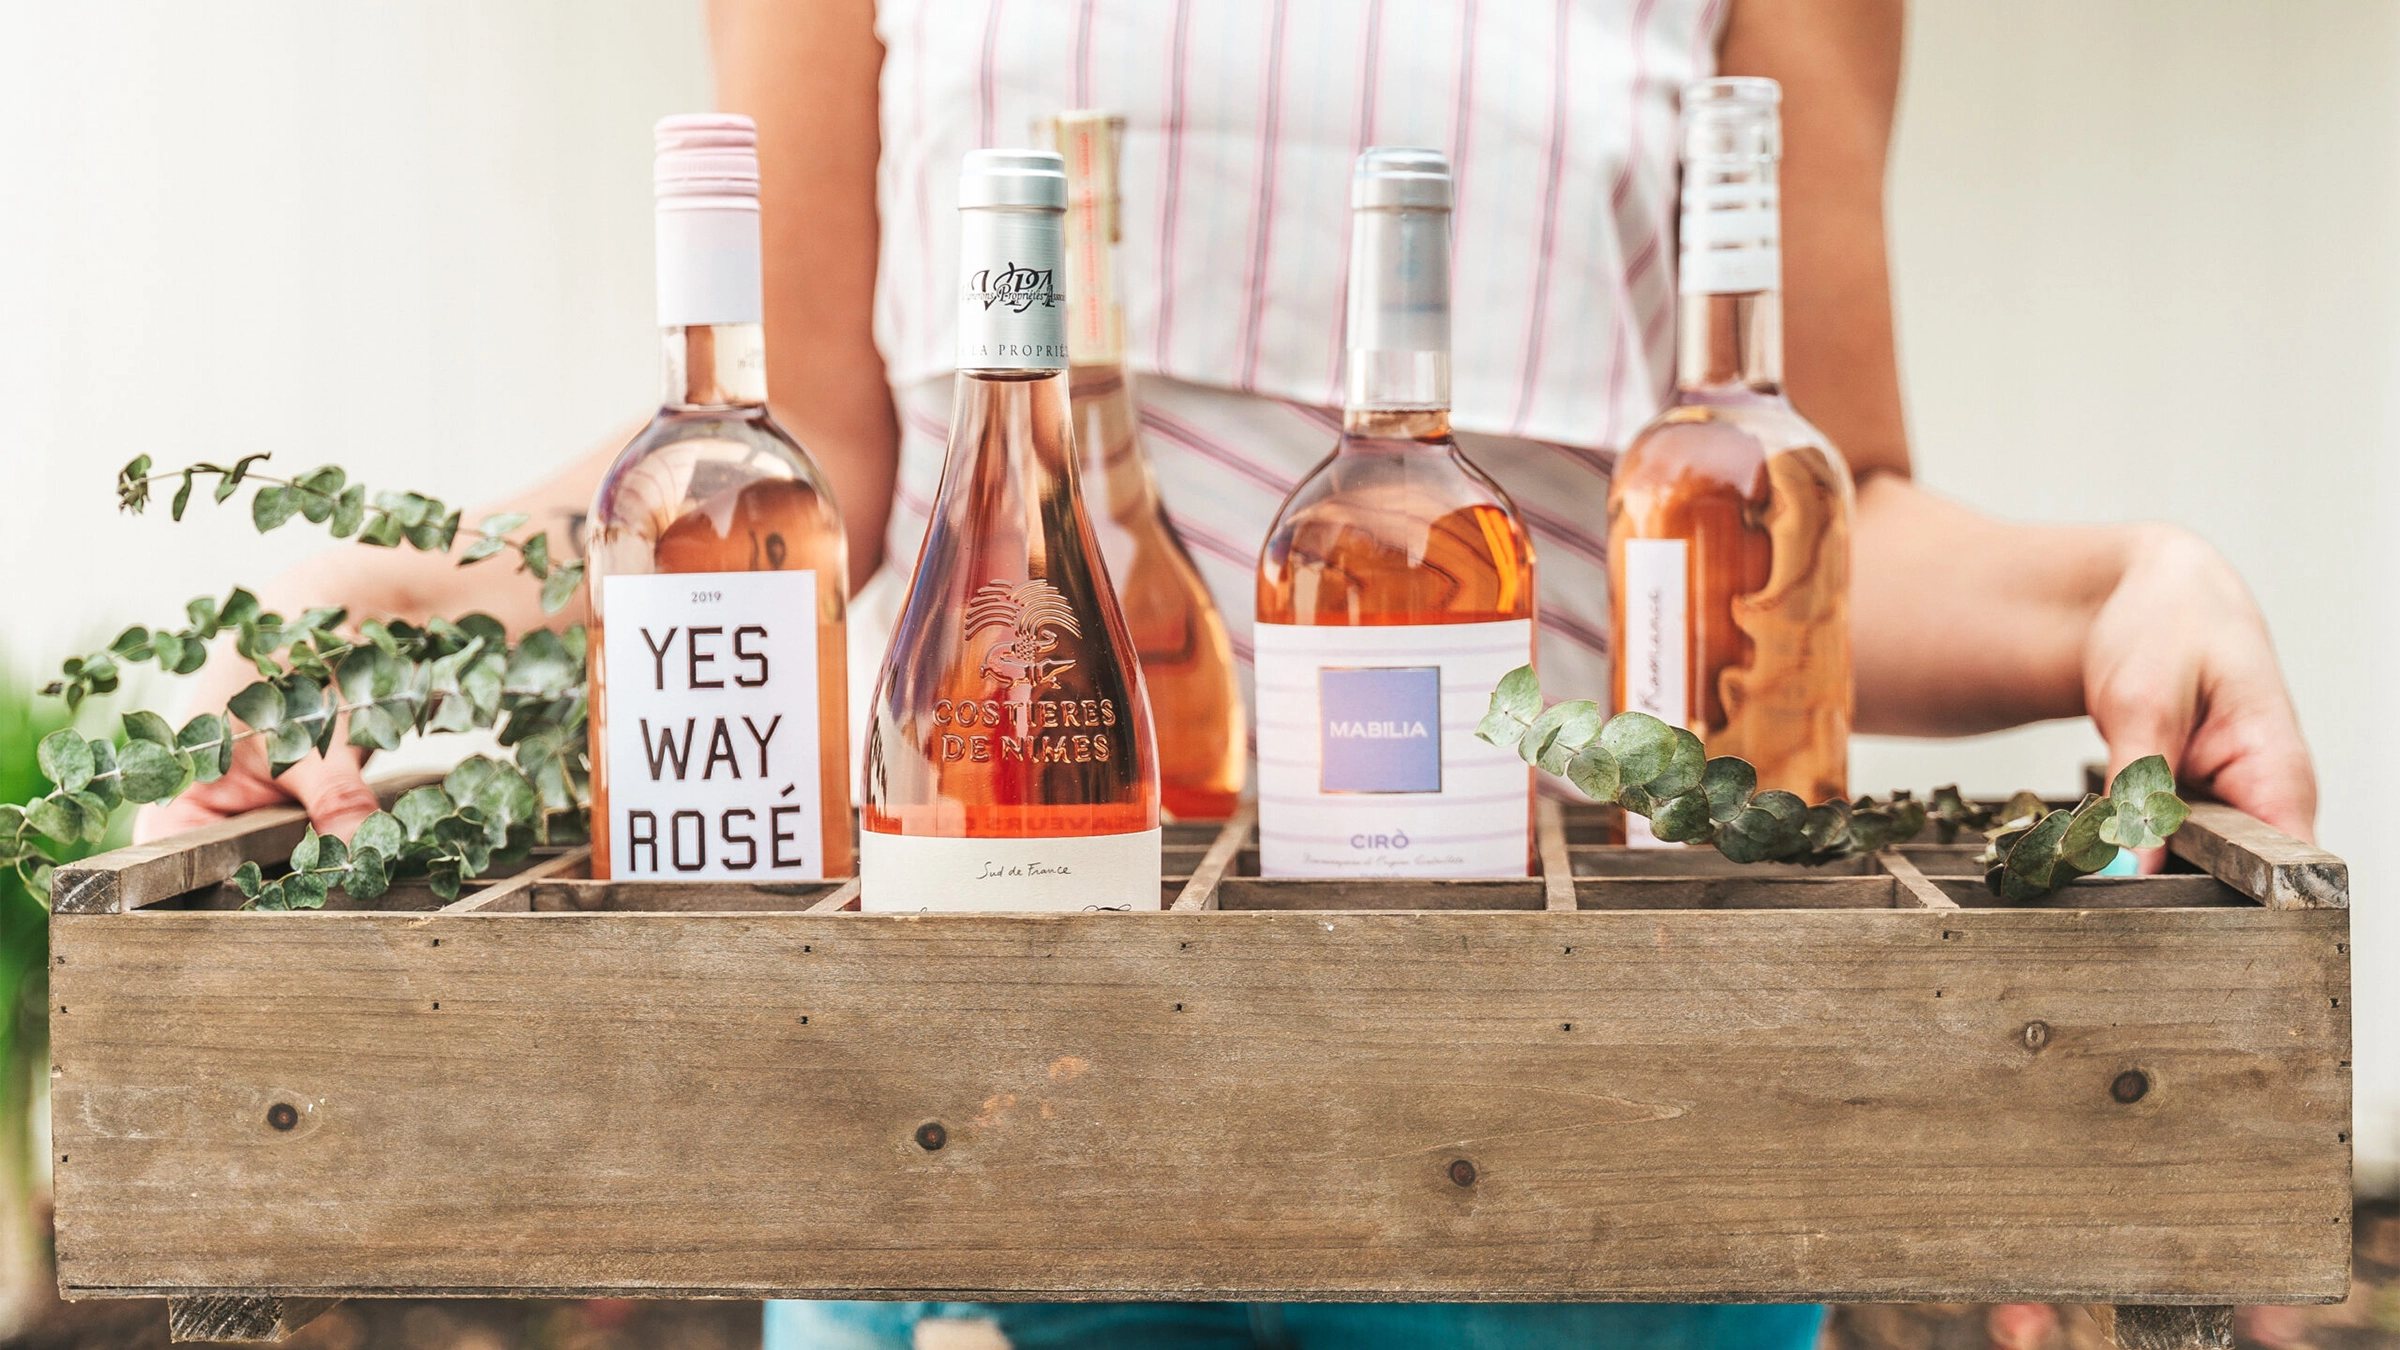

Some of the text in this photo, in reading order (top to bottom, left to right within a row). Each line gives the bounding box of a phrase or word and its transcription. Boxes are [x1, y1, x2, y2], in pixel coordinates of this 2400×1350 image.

[690, 591, 722, 603] 2019
[639, 624, 769, 690] YES
[931, 697, 1117, 728] COSTIERES
[1329, 720, 1428, 739] MABILIA
[639, 713, 783, 781] WAY
[941, 732, 1112, 764] DE NIMES
[628, 782, 802, 873] ROSÉ
[1350, 828, 1410, 849] CIRÒ
[976, 861, 1073, 880] Sud de France
